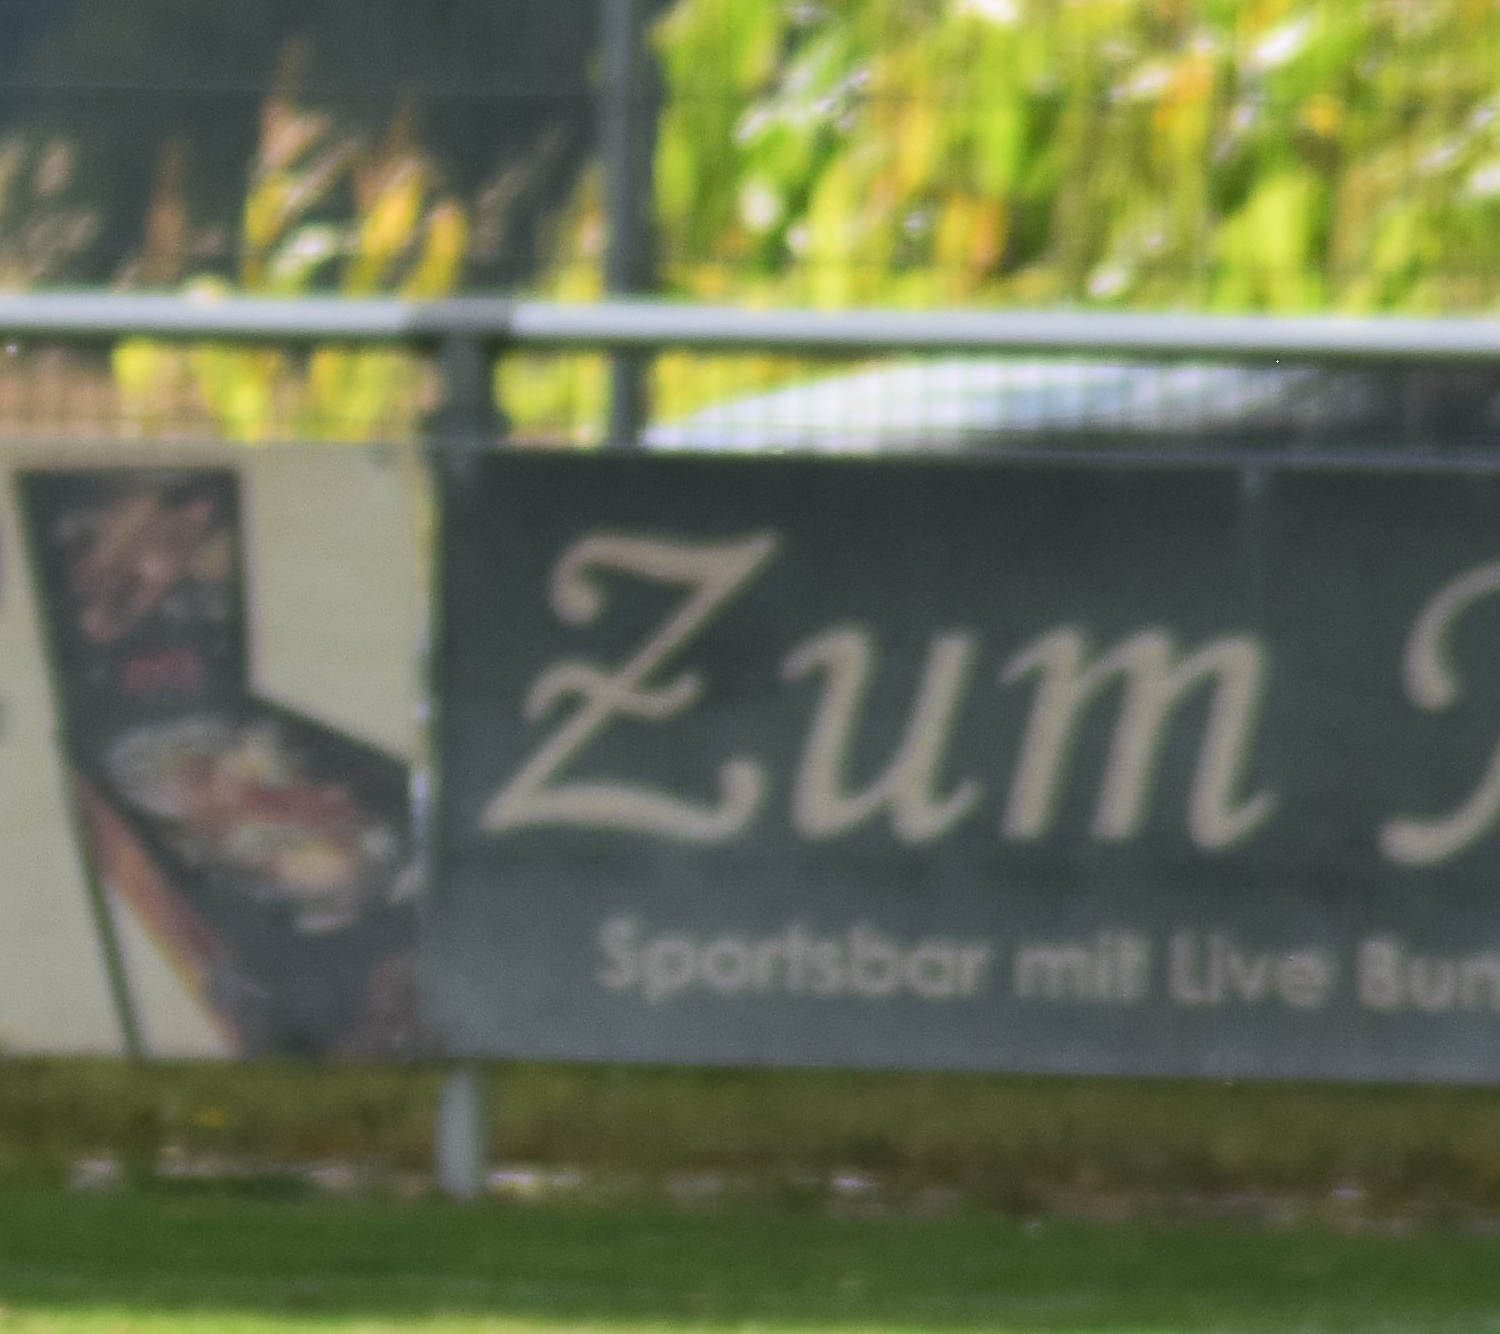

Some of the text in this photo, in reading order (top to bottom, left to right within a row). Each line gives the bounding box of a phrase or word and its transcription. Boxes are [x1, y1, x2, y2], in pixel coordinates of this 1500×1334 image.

[481, 529, 1279, 851] Zum
[596, 915, 993, 1003] Sportsbar
[1013, 927, 1151, 1001] mit
[1170, 931, 1332, 1008] Live
